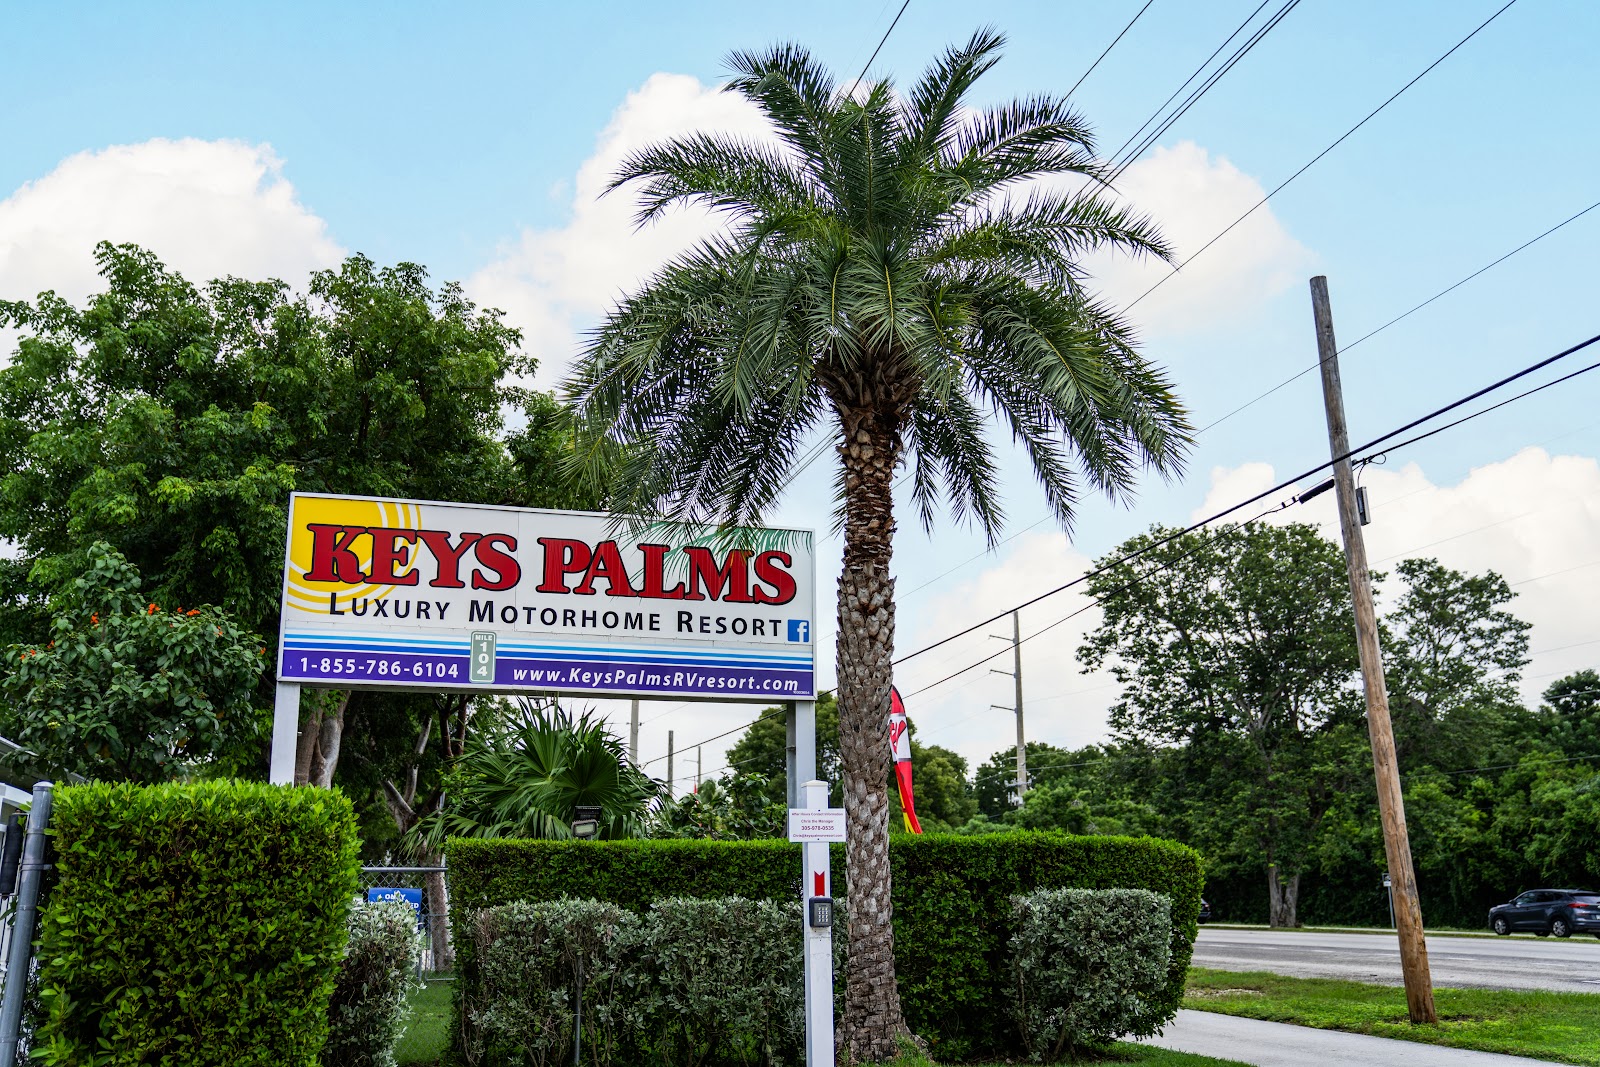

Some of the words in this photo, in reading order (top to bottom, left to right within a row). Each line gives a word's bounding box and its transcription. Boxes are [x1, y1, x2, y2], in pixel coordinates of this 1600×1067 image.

[303, 523, 521, 591] KEYS
[535, 537, 797, 606] PALMS
[329, 592, 451, 620] LUXURY
[468, 600, 661, 632] MOTORHOME
[677, 610, 782, 637] RESORT
[300, 657, 459, 678] 1-855-786-6104
[513, 667, 798, 691] www.KeysPalmsRVresort.com
